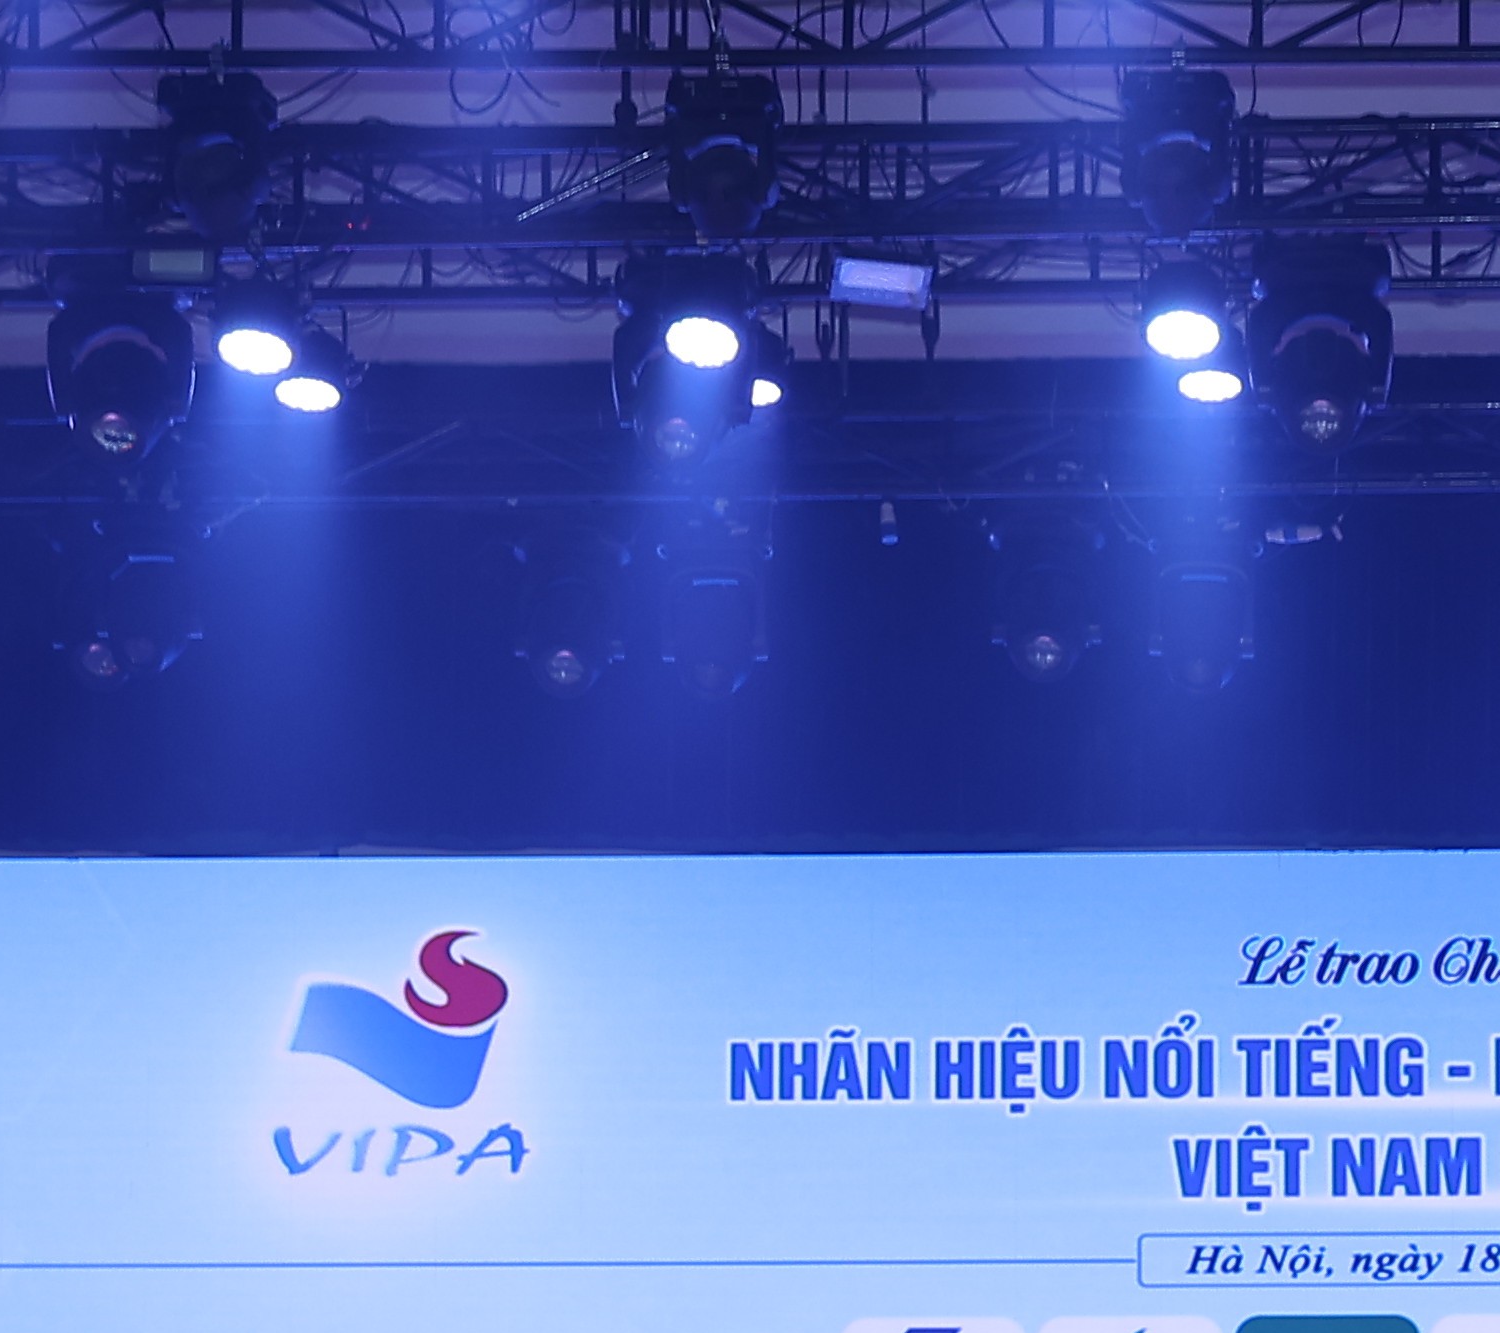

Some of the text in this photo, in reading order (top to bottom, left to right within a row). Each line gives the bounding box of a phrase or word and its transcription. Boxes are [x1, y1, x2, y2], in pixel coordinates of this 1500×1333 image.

[1238, 935, 1315, 986] Lễ
[1317, 943, 1419, 986] trao
[730, 1028, 911, 1101] NHÃN
[934, 1027, 1080, 1113] HIỆU
[1105, 1014, 1214, 1098] NỔI
[1238, 1018, 1425, 1098] TIẾNG
[272, 1121, 530, 1178] VIPA
[1173, 1125, 1309, 1211] VIỆT
[1331, 1138, 1481, 1197] NAM
[1186, 1245, 1243, 1275] Hà
[1256, 1245, 1335, 1279] Nội,
[1349, 1246, 1443, 1281] ngày
